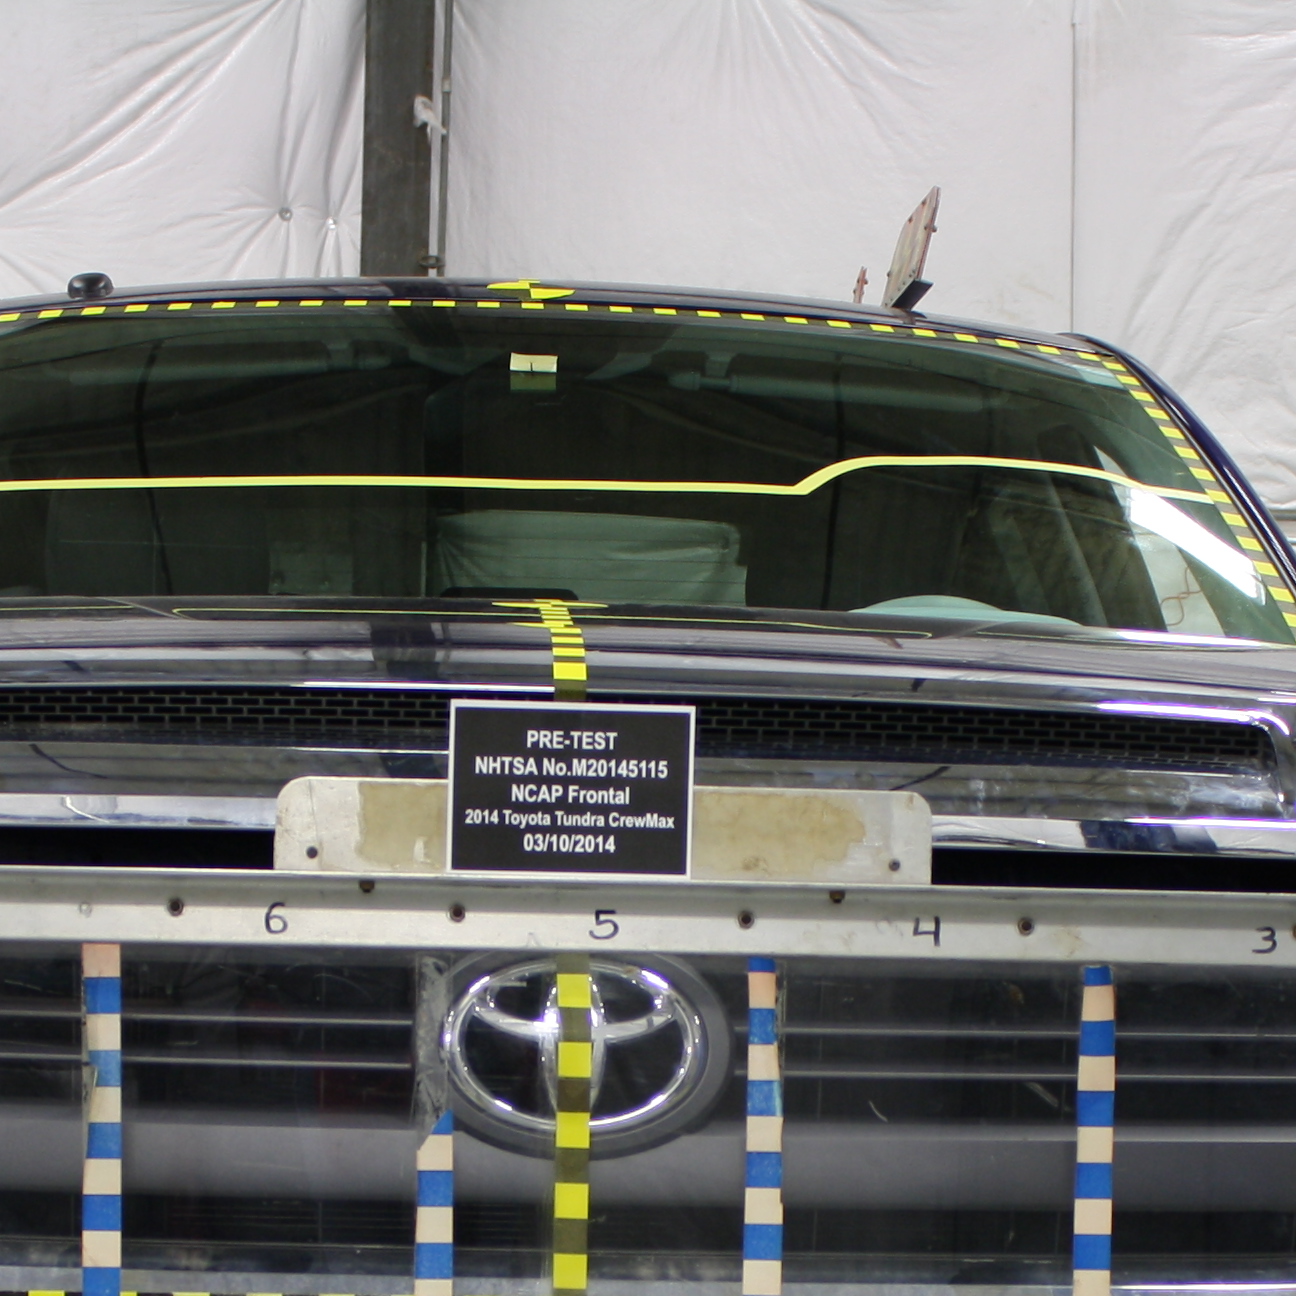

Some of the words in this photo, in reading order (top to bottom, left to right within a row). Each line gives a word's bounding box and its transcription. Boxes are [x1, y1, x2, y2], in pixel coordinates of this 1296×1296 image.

[527, 730, 618, 750] PRE-TEST
[475, 756, 539, 776] NHTSA
[511, 784, 564, 803] NCAP
[568, 786, 630, 805] Frontal
[465, 809, 499, 825] 2014
[502, 810, 552, 829] Toyota
[555, 811, 605, 828] Tundra
[609, 812, 675, 829] CrewMax
[524, 834, 616, 854] 03/10/2014
[263, 901, 289, 935] 6
[588, 910, 619, 940] 5
[913, 915, 941, 947] 4
[1252, 926, 1278, 954] 3
